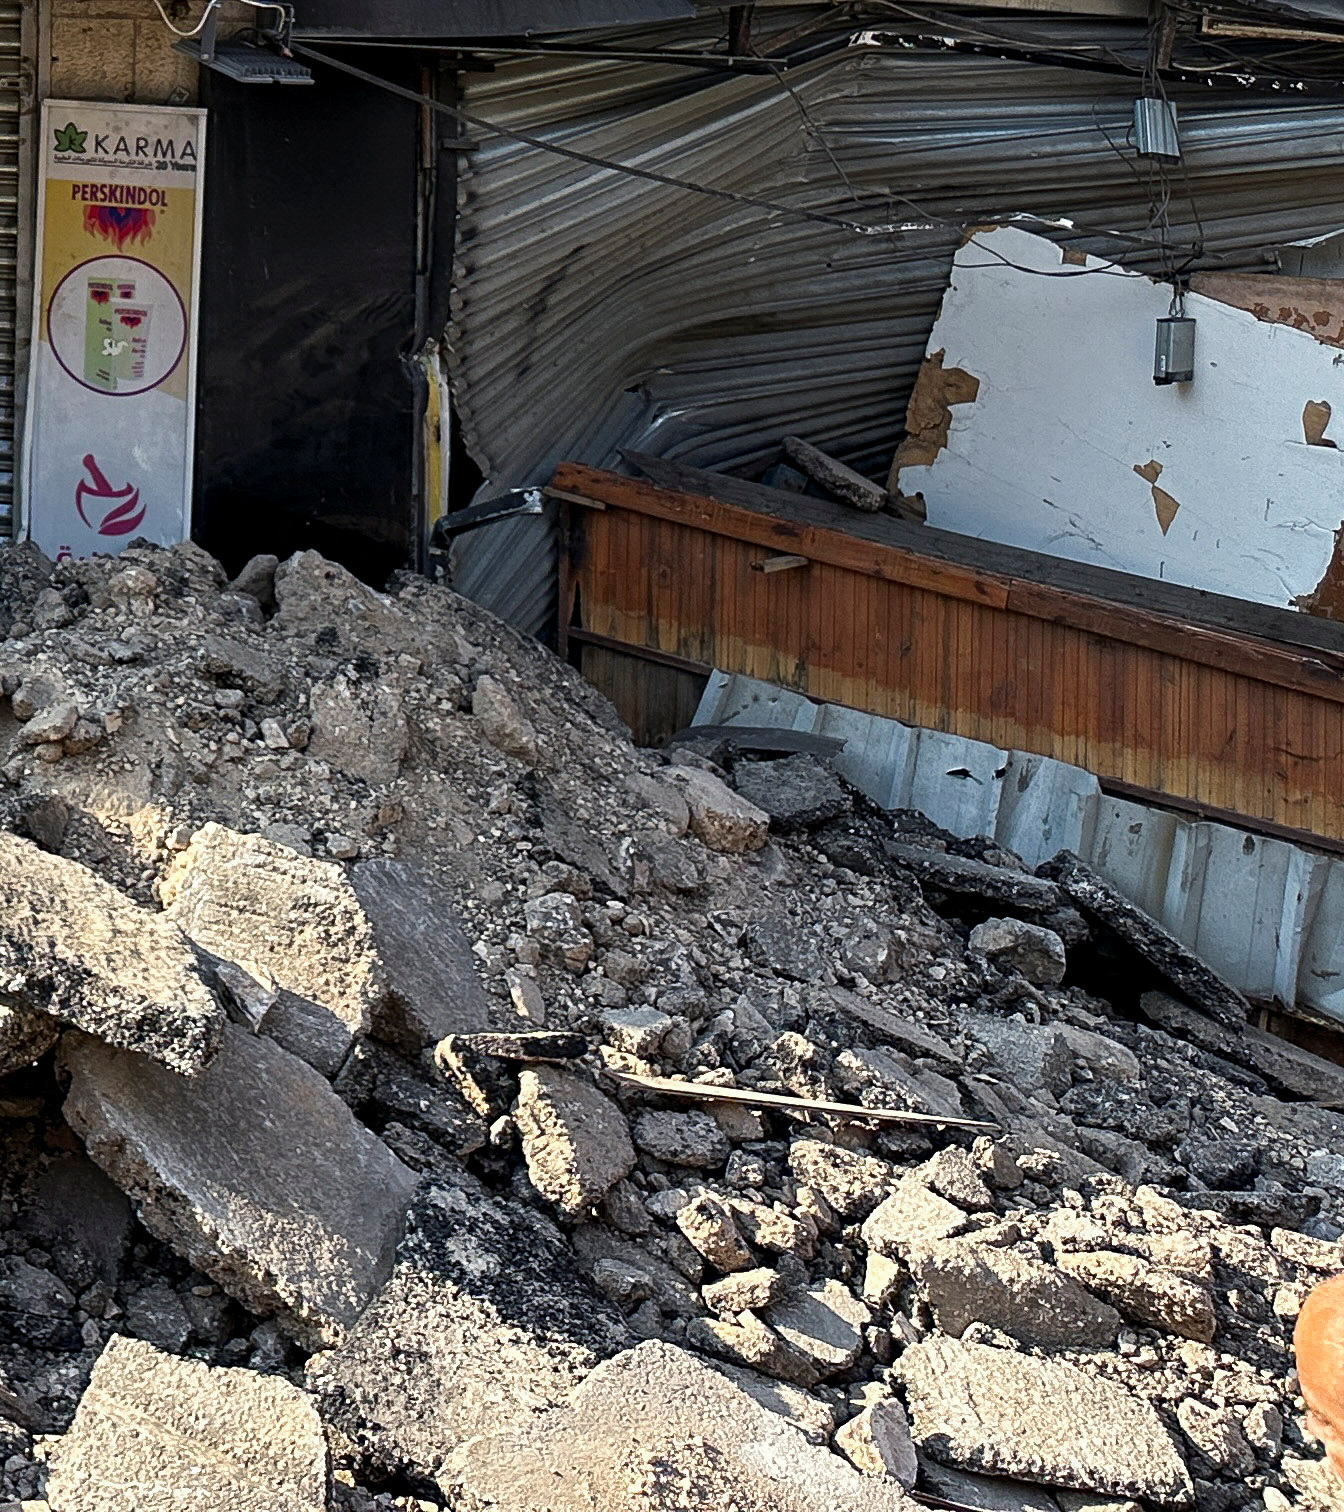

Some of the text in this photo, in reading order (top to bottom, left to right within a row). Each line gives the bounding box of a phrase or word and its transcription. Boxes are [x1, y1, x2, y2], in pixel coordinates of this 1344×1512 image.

[94, 133, 197, 161] KARMA
[155, 160, 168, 171] 20
[72, 183, 169, 207] PERSKINDOL
